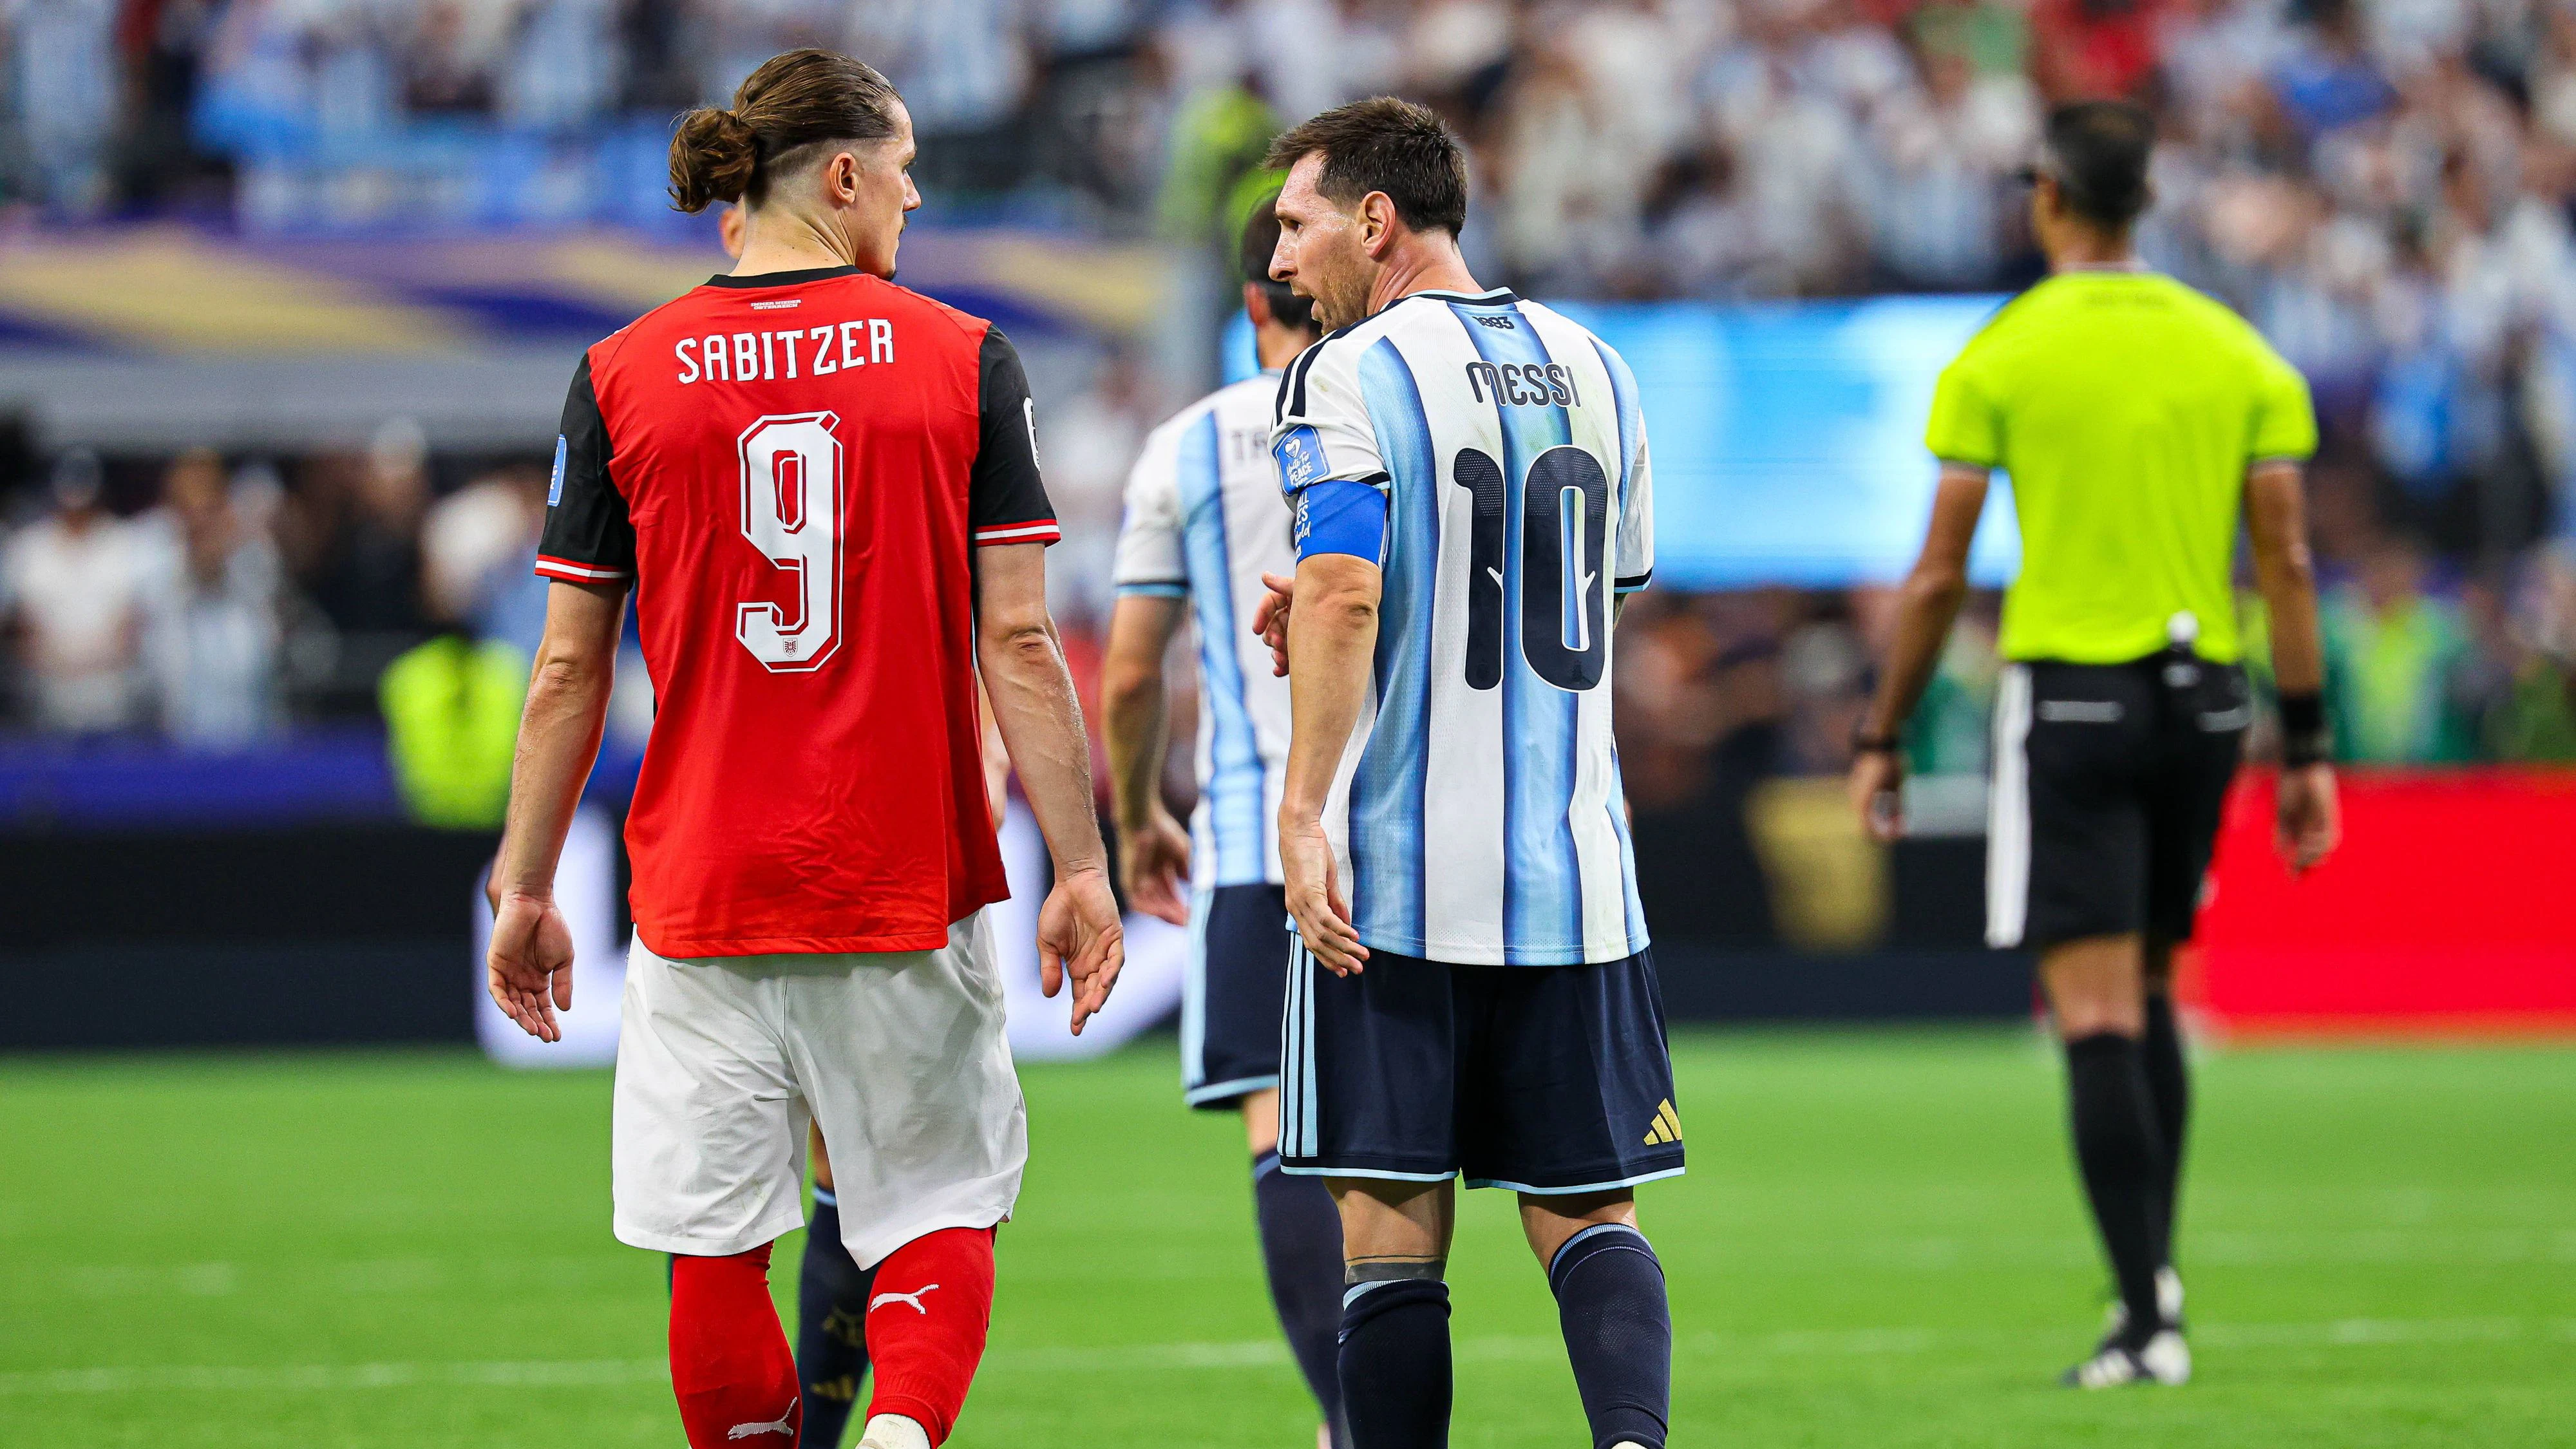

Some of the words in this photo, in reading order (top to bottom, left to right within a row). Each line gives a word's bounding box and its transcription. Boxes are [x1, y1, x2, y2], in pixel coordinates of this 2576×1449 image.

[675, 318, 895, 385] SABITZER
[1465, 361, 1582, 407] MESSI
[1289, 461, 1314, 486] PEACE
[735, 410, 844, 674] 9
[1454, 444, 1608, 693] 10
